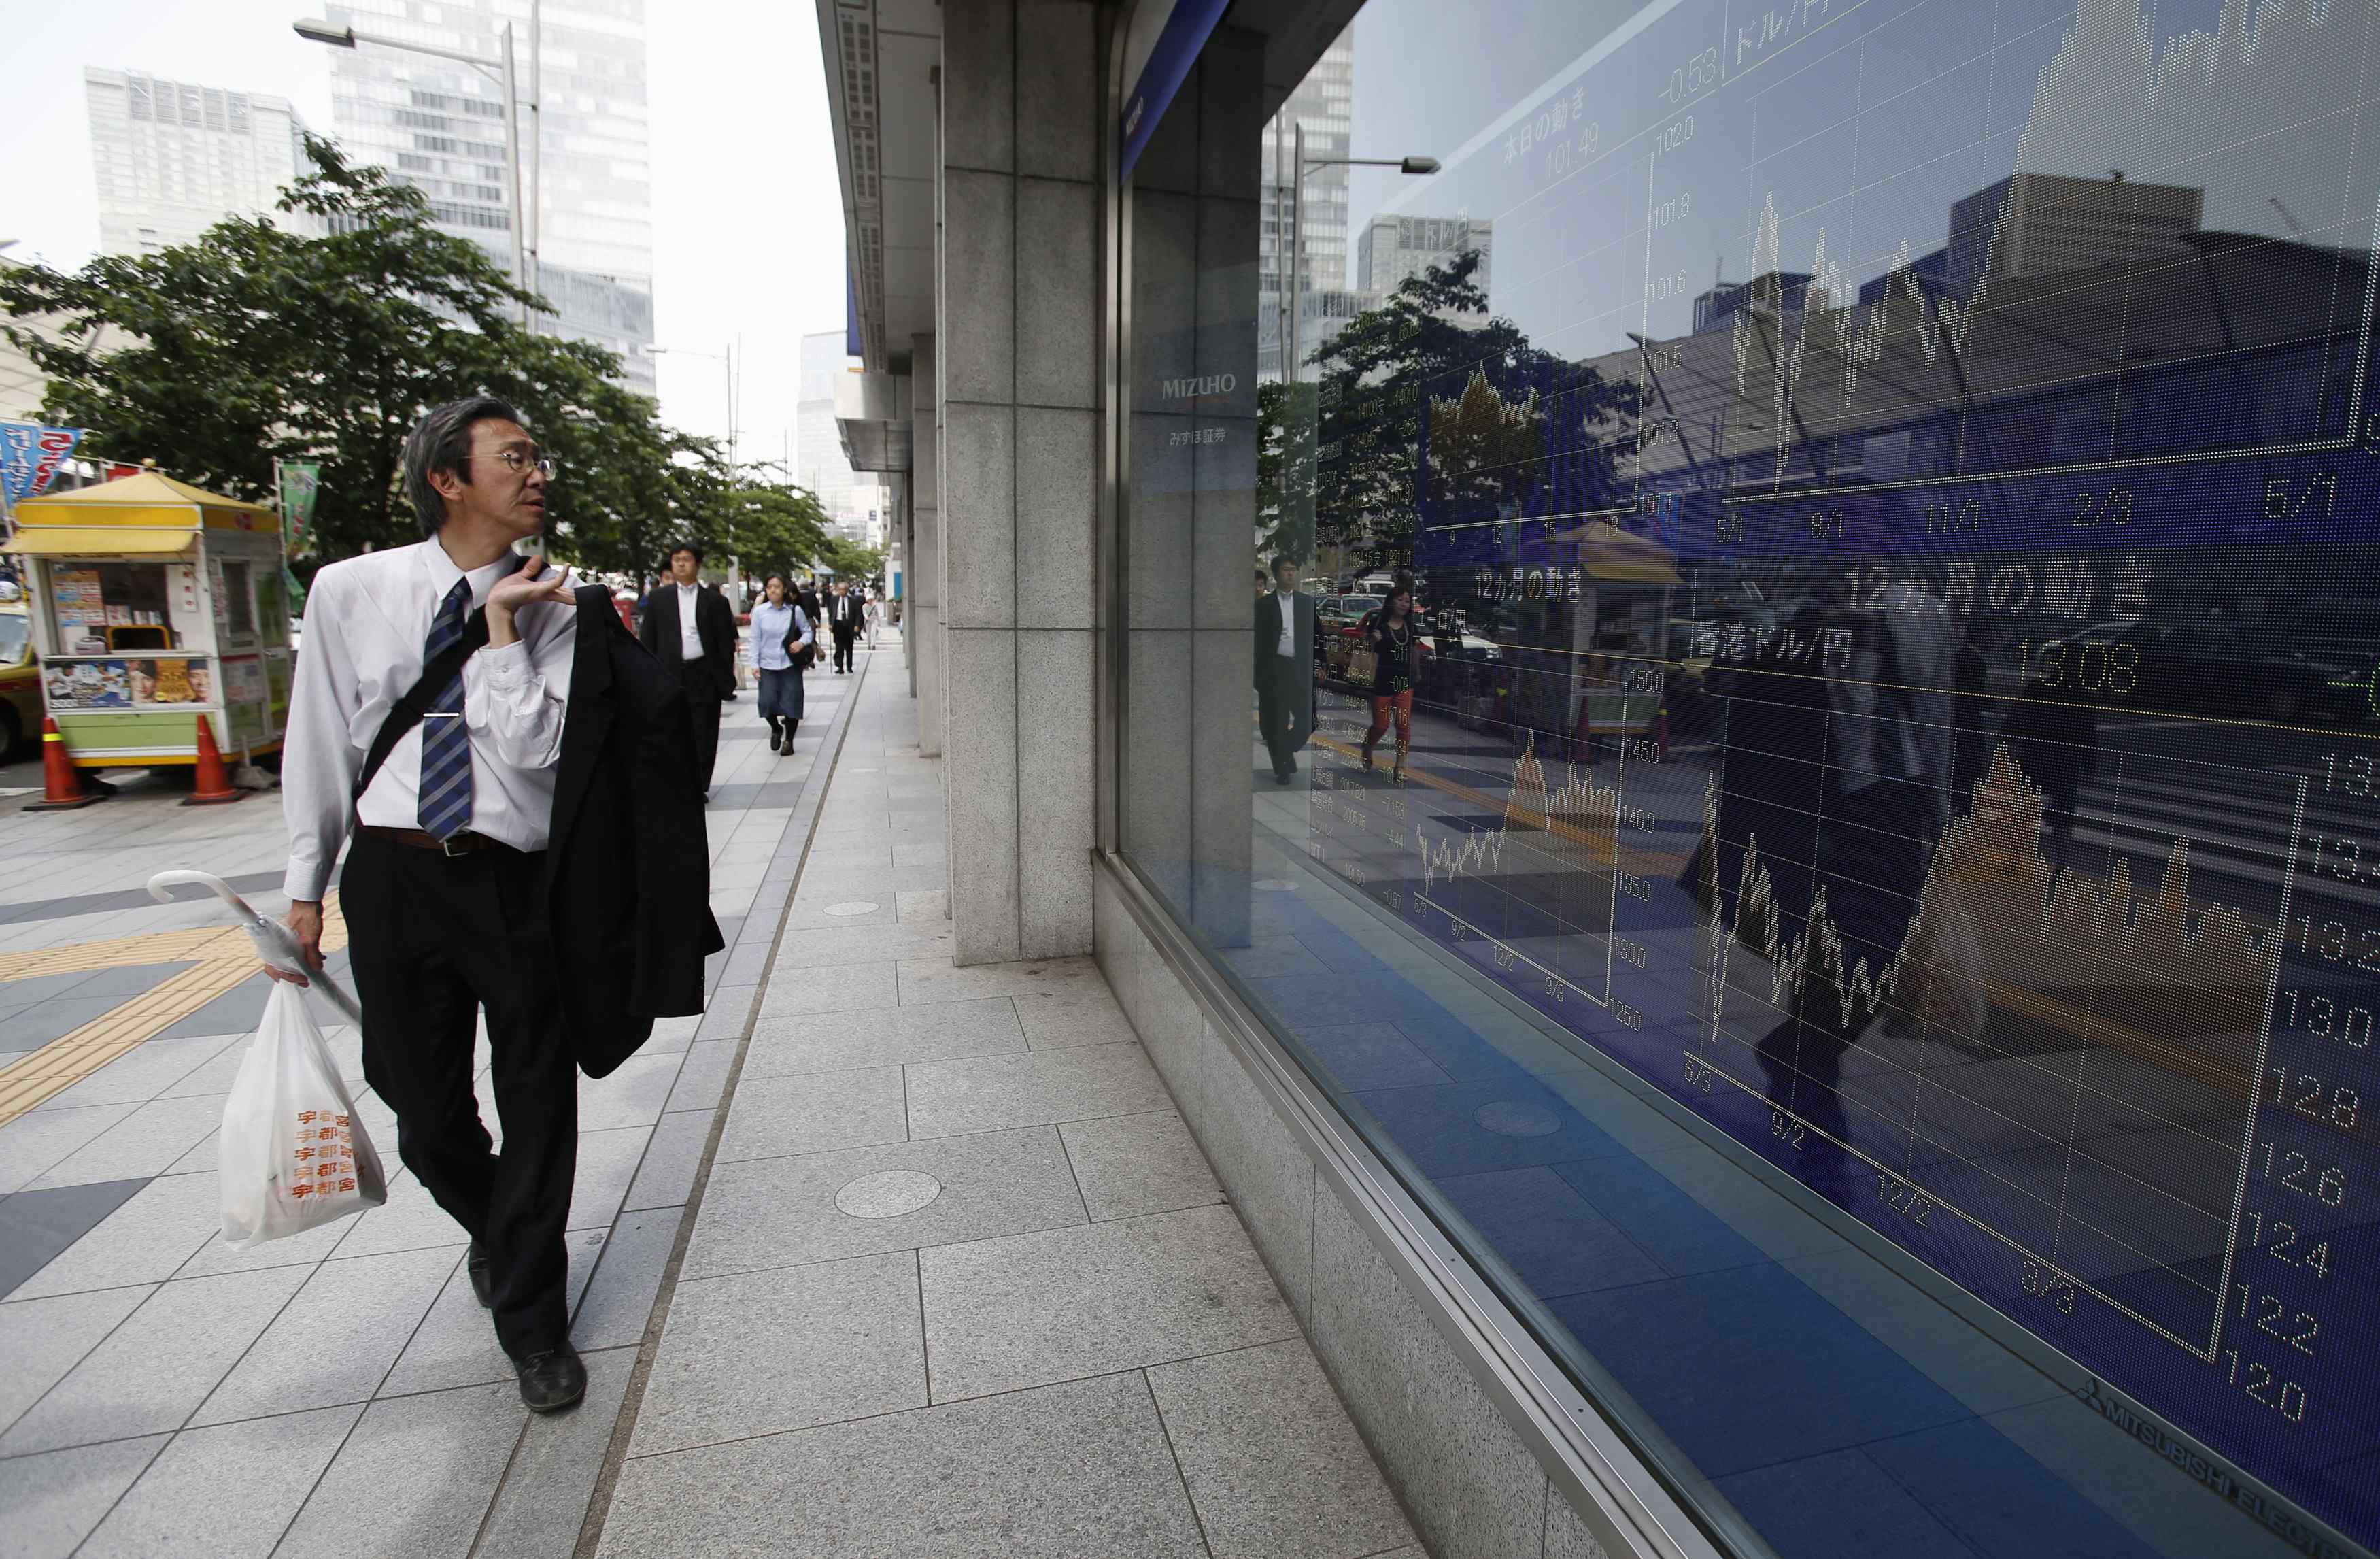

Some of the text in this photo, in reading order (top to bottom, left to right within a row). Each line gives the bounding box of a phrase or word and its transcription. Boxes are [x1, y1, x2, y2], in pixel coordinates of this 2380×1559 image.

[1503, 86, 1584, 165] 本日の動き
[1656, 116, 1693, 155] 102.0
[1654, 192, 1690, 229] 101.8
[1647, 345, 1682, 375] 101.5
[1162, 374, 1236, 400] MIZUHO
[1170, 427, 1226, 446] みずほ証券
[2073, 488, 2132, 526] 2/3
[2265, 473, 2337, 518] 5/1
[1492, 526, 1503, 544] 12
[1812, 509, 1843, 538] 8/1
[1925, 499, 1979, 533] 11/1
[1697, 620, 1853, 670] 香港ドル/円
[1631, 669, 1665, 694] 150.0
[2019, 639, 2139, 692] 13.08
[1626, 737, 1660, 765] 145.0
[1622, 804, 1655, 834] 140.0
[1618, 871, 1650, 902] 135.0
[1614, 935, 1646, 969] 130.0
[1610, 996, 1642, 1032] 125.0
[2285, 990, 2373, 1048] 13.0
[1683, 1060, 1712, 1093] 6/3
[2273, 1067, 2359, 1129] 12.8
[1771, 1111, 1807, 1151] 9/2
[2260, 1142, 2345, 1207] 12.6
[1876, 1173, 1932, 1228] 12/2
[2249, 1211, 2329, 1279] 12.4
[2021, 1259, 2075, 1315] 3/3
[2238, 1283, 2318, 1356] 12.2
[2226, 1349, 2307, 1423] 12.0
[2107, 1397, 2231, 1494] MITSUBISHI
